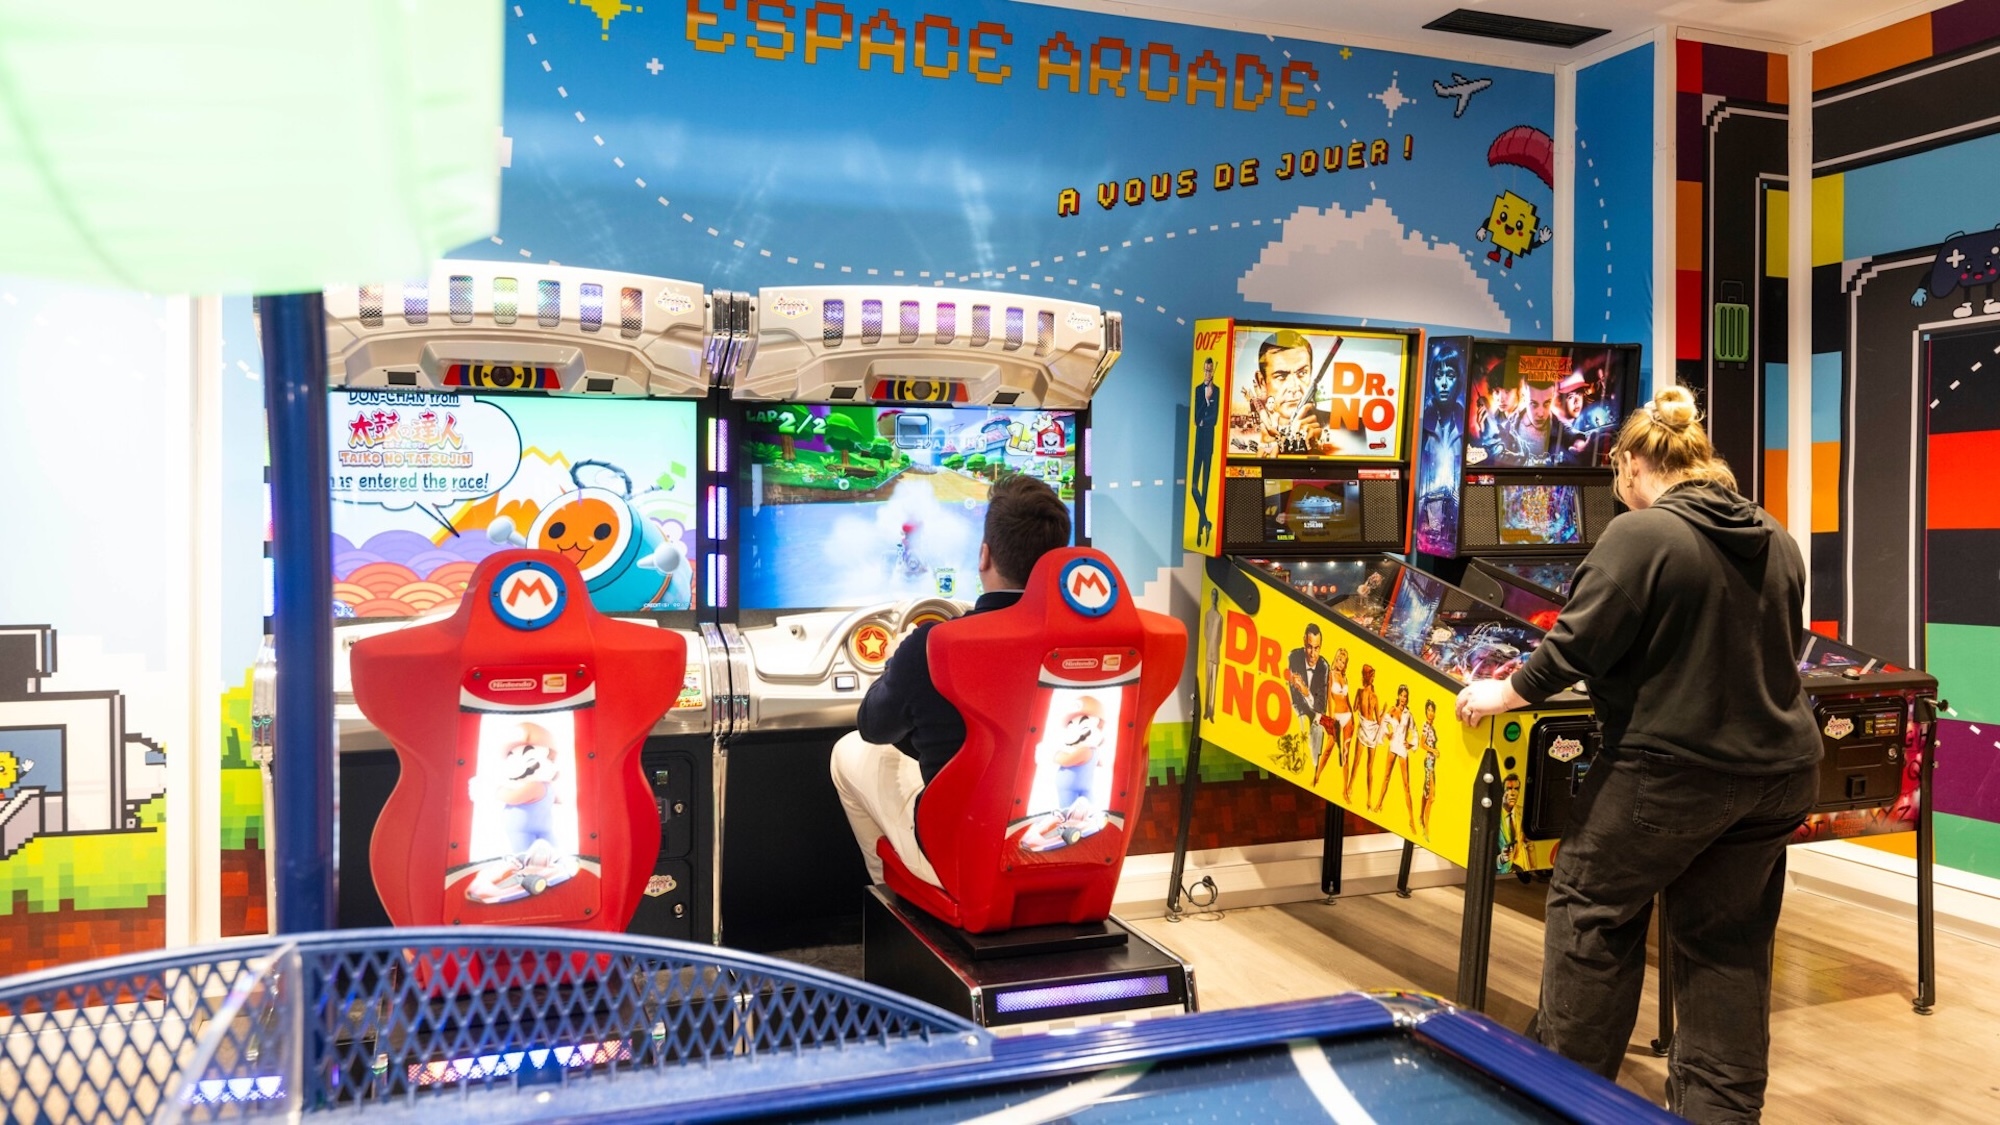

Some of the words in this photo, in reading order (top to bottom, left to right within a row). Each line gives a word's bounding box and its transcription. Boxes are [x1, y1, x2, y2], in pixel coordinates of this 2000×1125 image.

[686, 0, 1013, 86] ESPACE
[1037, 31, 1320, 118] ARCADE
[1057, 188, 1081, 217] A
[1097, 169, 1197, 210] VOUS
[1213, 158, 1260, 191] DE
[1401, 134, 1414, 161] !
[1196, 331, 1219, 351] 007
[348, 391, 426, 405] DON-CHAN
[429, 393, 460, 406] from
[745, 409, 778, 423] LAP
[778, 411, 828, 435] 2/2
[1329, 397, 1396, 433] NO
[348, 409, 463, 449] 太鼓の達人
[339, 451, 380, 467] TAIKO
[382, 452, 404, 467] NO
[405, 452, 473, 468] TATSUJIN
[359, 472, 418, 491] entered
[423, 473, 448, 490] the
[451, 472, 490, 491] race!
[505, 577, 553, 608] M
[1072, 571, 1108, 598] M
[1065, 660, 1096, 668] Nintendo
[492, 680, 533, 689] Nintendo
[1222, 663, 1293, 736] NO
